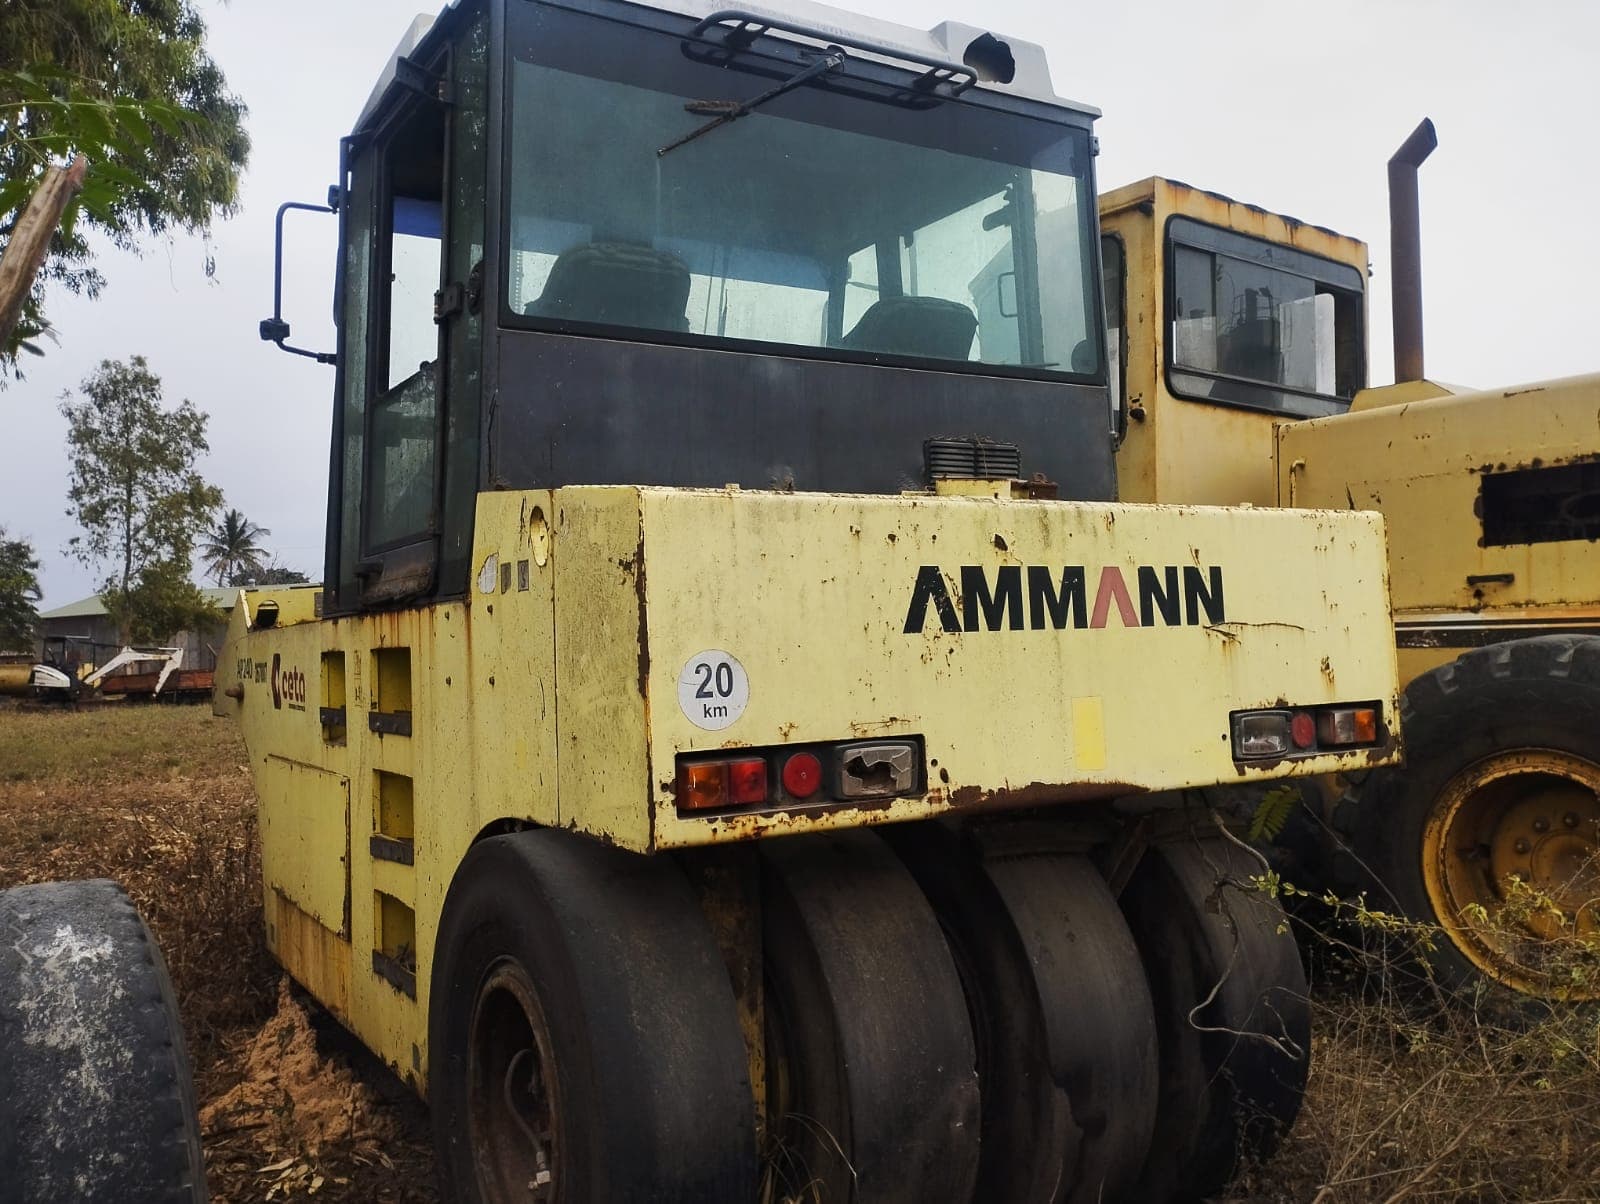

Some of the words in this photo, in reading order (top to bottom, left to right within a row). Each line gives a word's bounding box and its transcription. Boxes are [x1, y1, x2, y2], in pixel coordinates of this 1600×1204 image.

[903, 566, 1226, 634] AMMANN
[282, 666, 305, 702] ceta
[695, 662, 734, 698] 20
[703, 703, 728, 718] km
